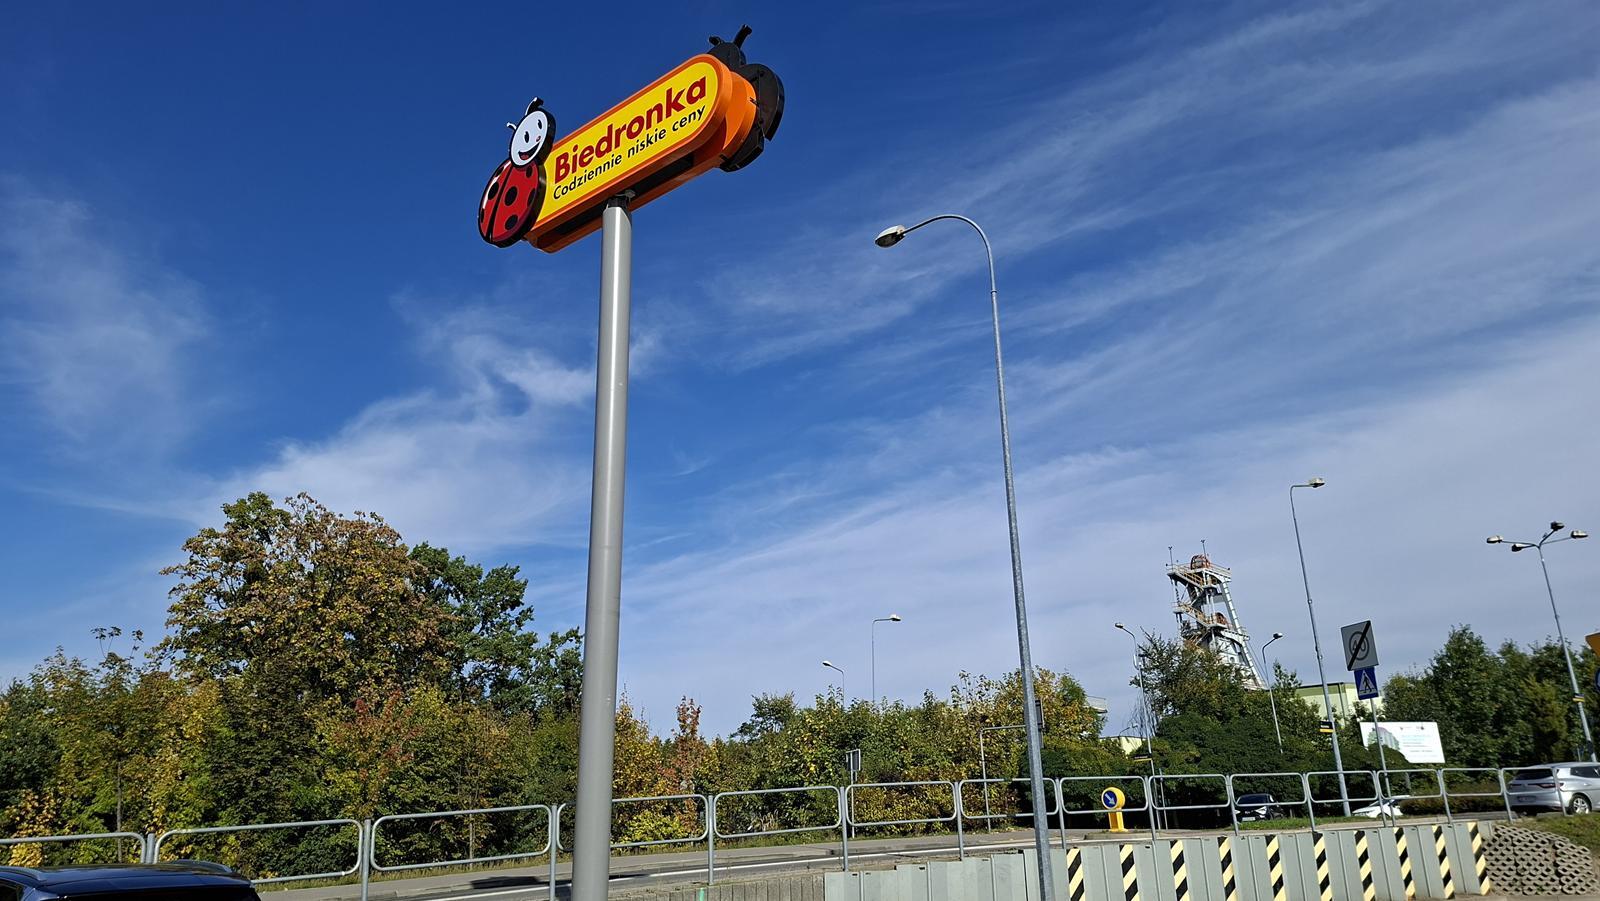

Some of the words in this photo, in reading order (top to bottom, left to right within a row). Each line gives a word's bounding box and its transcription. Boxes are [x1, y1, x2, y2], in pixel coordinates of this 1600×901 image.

[553, 153, 622, 200] Codziennie
[627, 128, 666, 159] niskie
[672, 105, 706, 132] ceny
[554, 76, 707, 185] Biedronka
